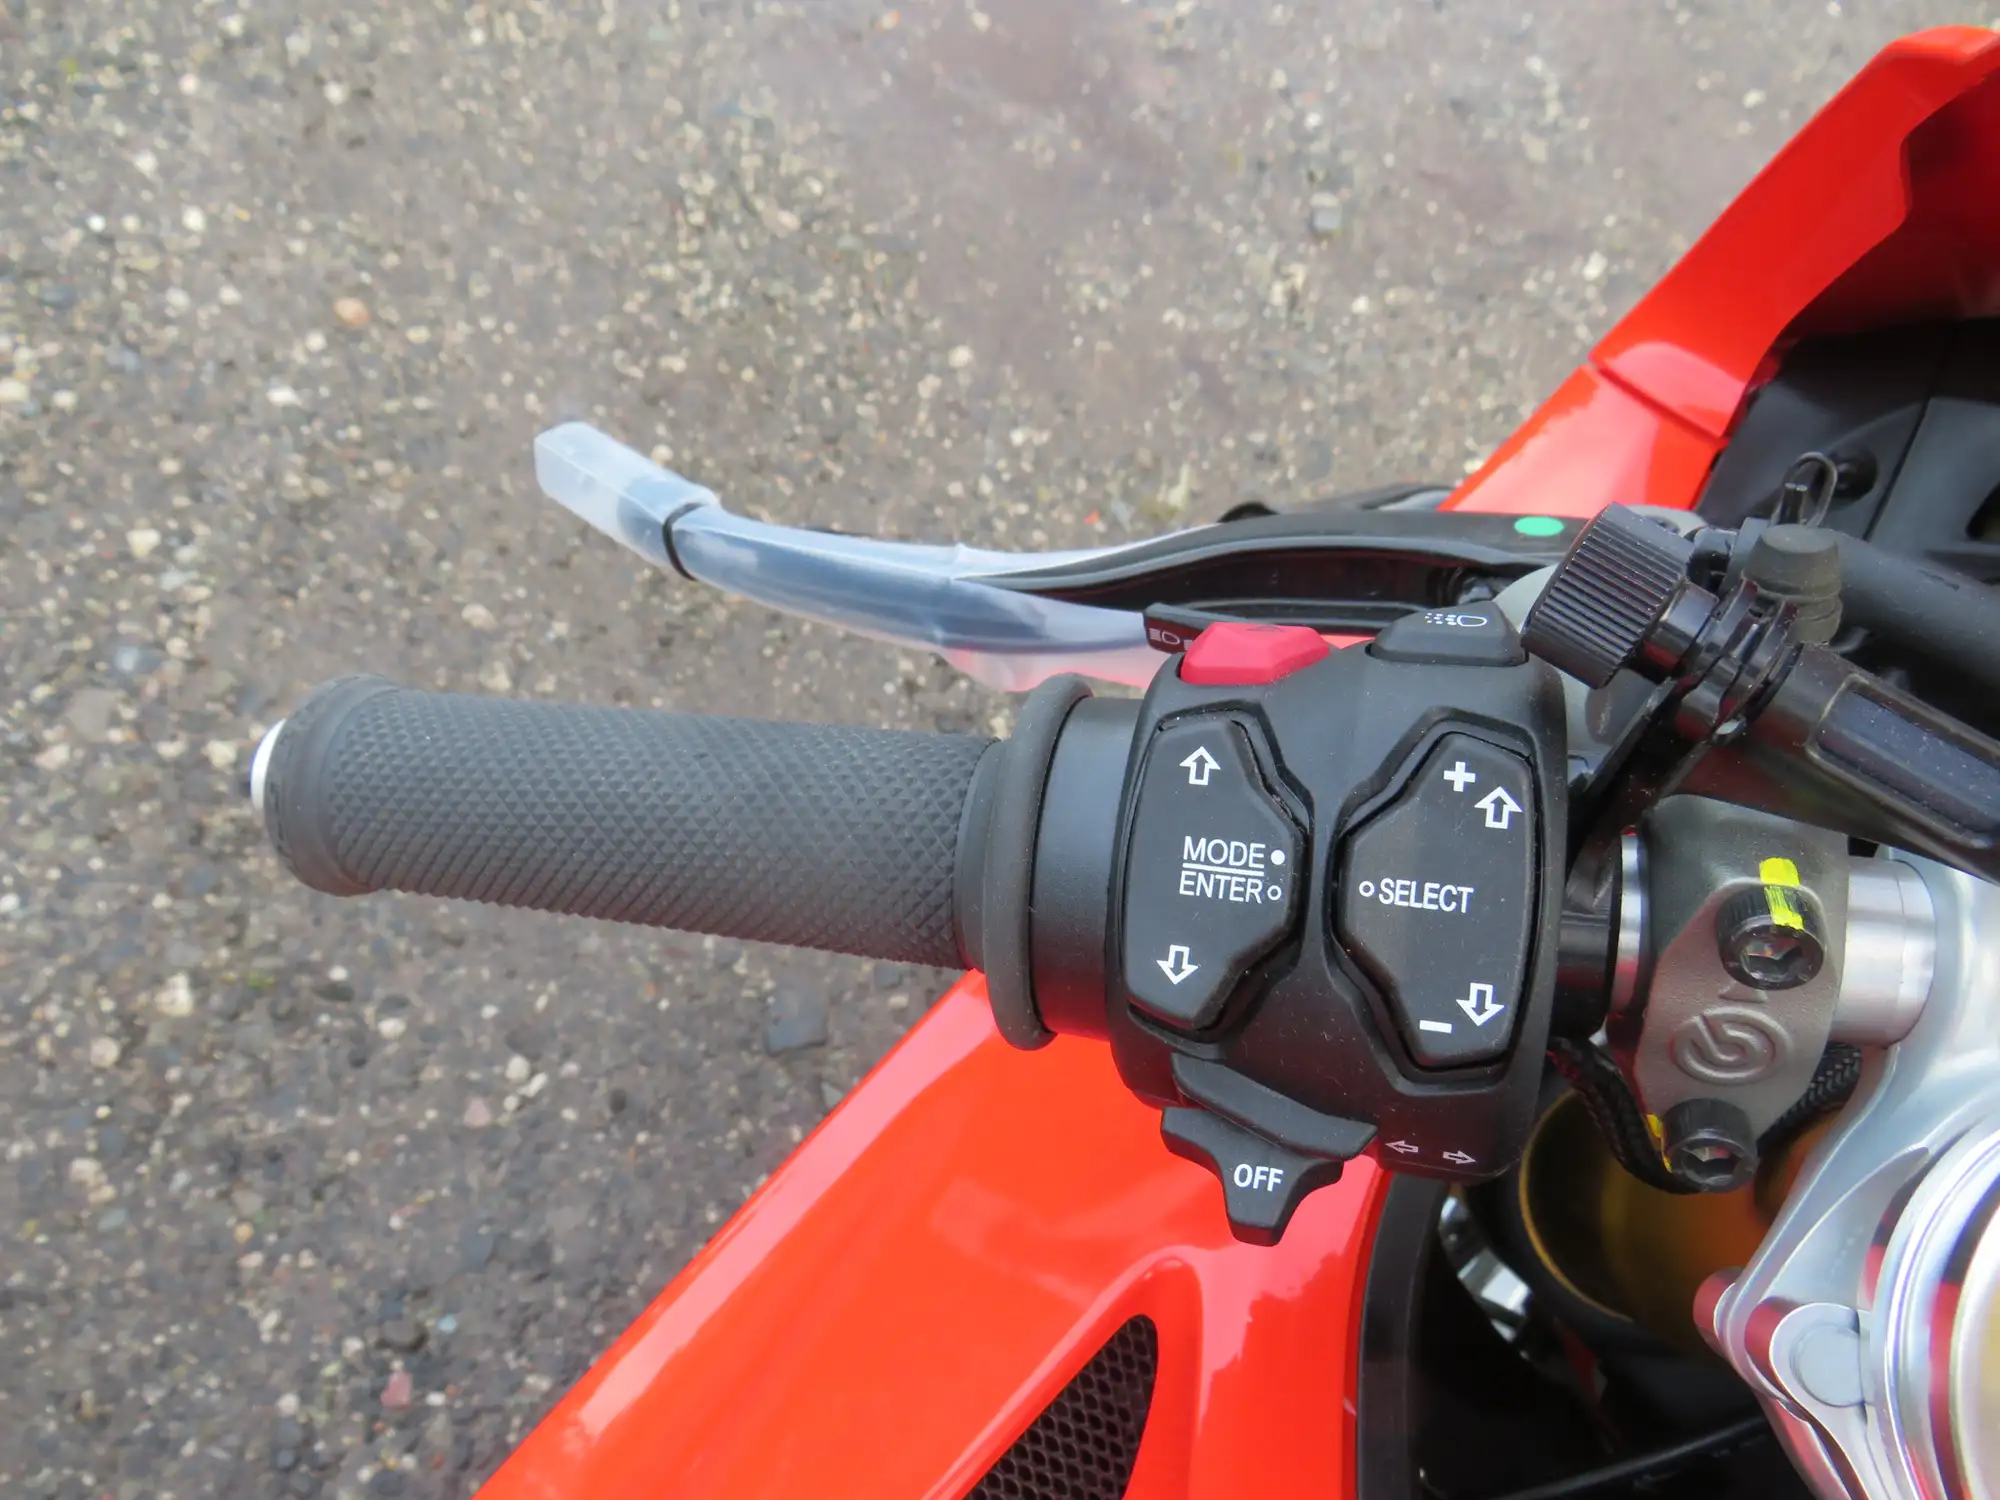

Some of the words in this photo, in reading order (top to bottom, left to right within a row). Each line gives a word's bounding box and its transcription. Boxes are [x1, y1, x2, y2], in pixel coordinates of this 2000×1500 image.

[1182, 835, 1266, 869] MODE
[1179, 870, 1263, 904] ENTER
[1378, 876, 1475, 914] SELECT
[1232, 1162, 1285, 1193] OFF
